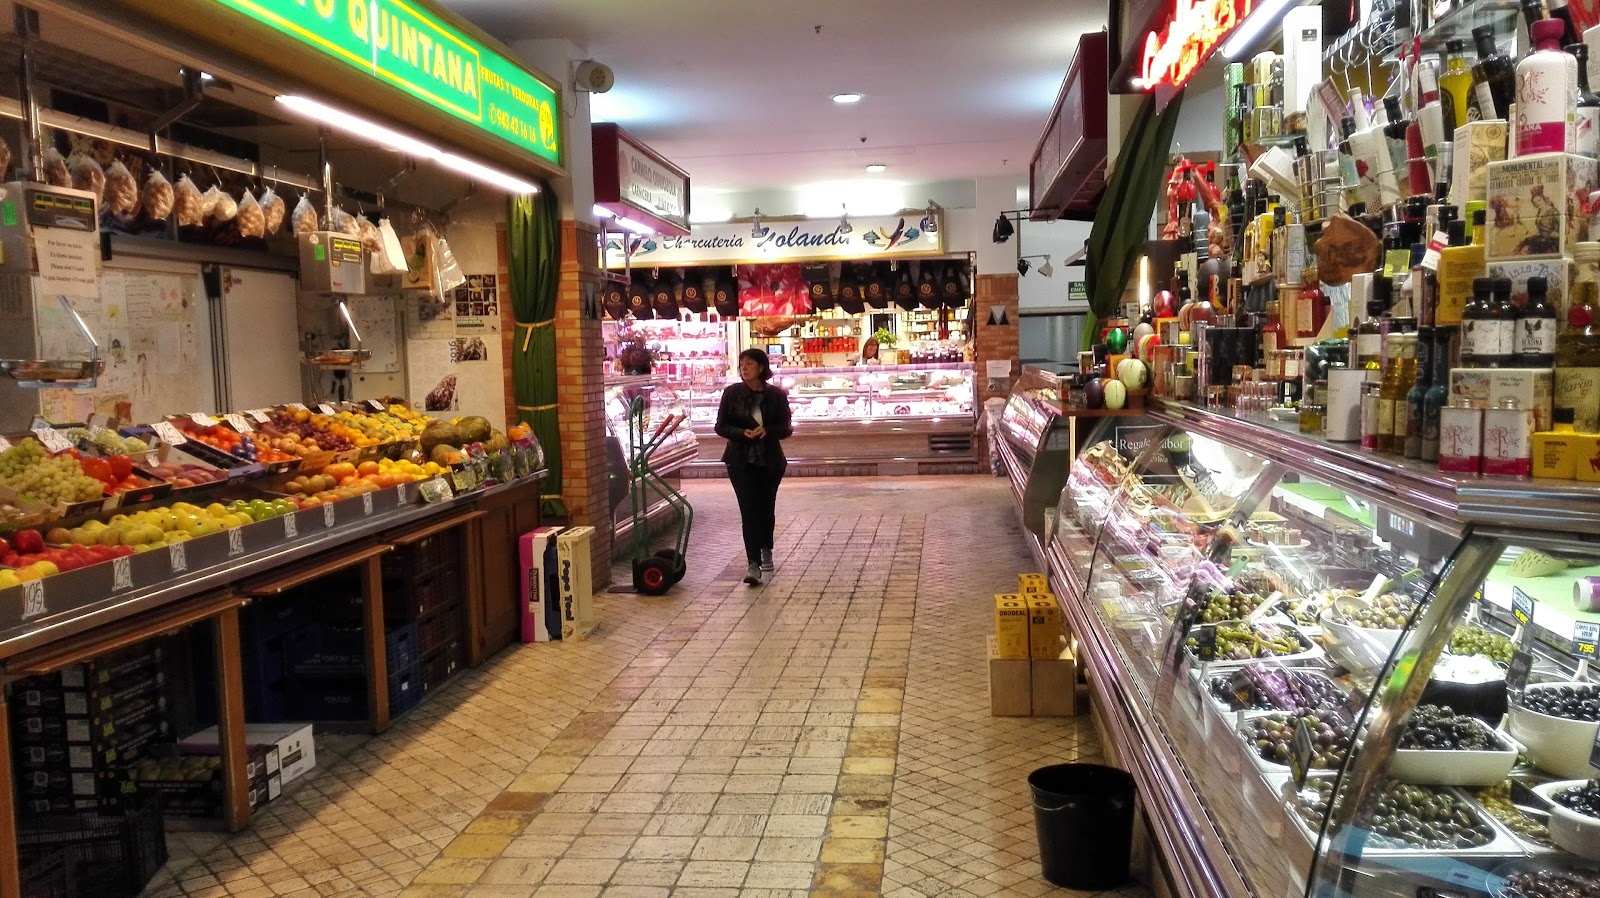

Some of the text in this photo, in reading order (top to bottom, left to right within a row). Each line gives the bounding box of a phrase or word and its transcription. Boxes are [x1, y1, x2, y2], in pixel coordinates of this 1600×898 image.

[347, 0, 478, 99] QUINTANA
[480, 65, 504, 91] FRUTAS
[1503, 160, 1544, 173] MONUMENTAL
[1161, 439, 1185, 449] abor
[1578, 642, 1596, 654] 795
